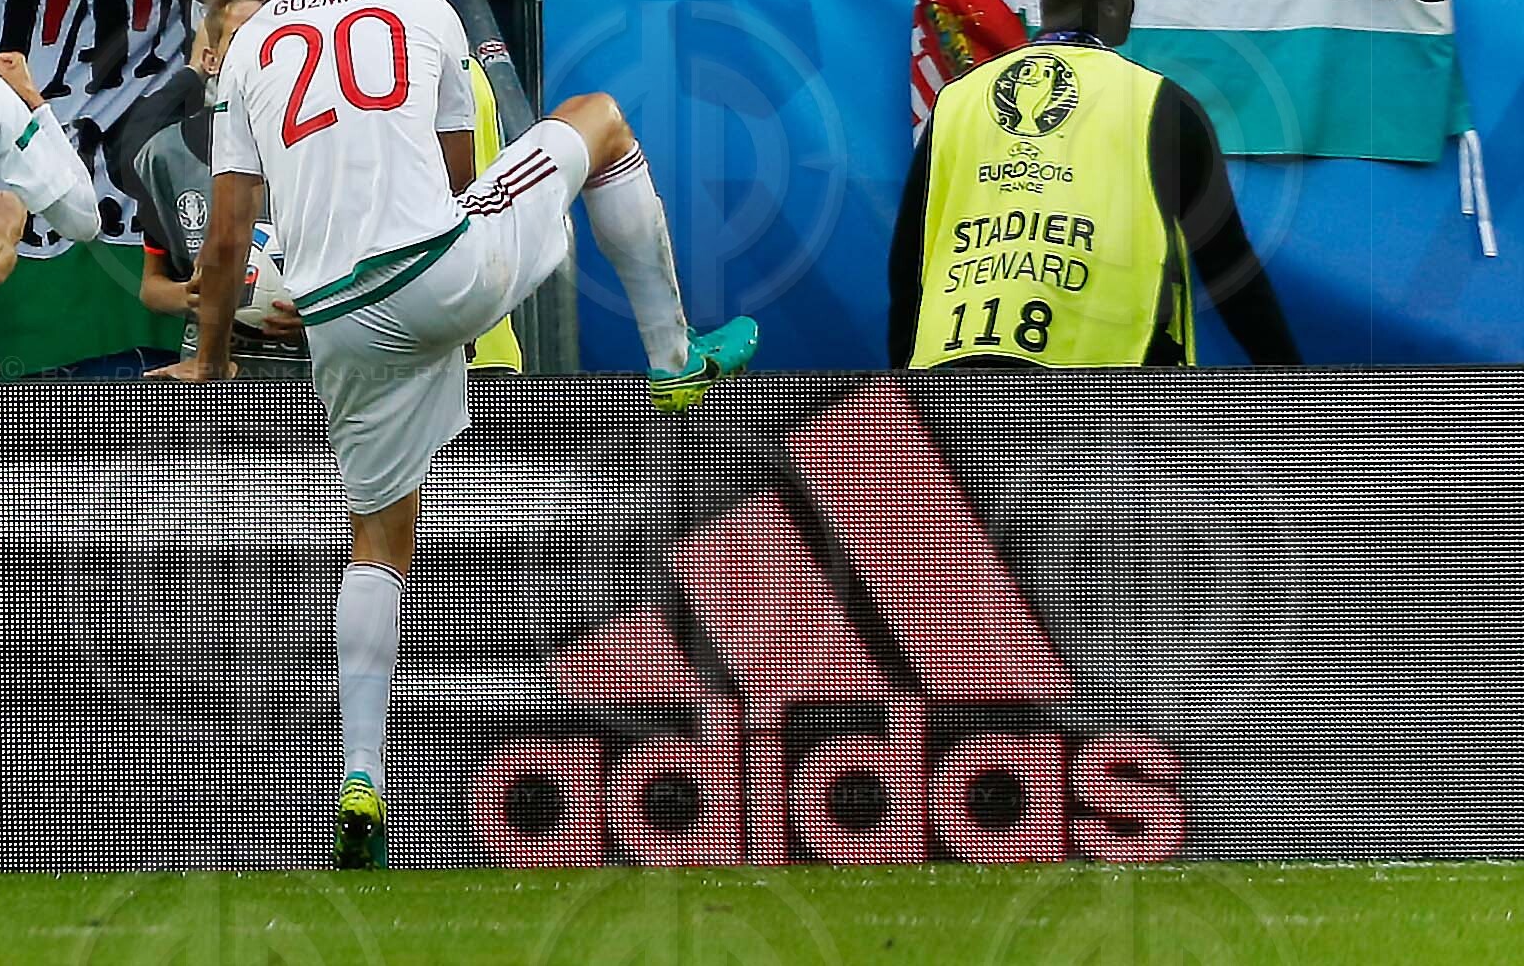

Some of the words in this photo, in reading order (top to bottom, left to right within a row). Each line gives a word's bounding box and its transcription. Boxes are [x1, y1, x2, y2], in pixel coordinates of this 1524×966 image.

[259, 6, 411, 150] 20
[978, 160, 1074, 183] EURO2016
[952, 210, 1095, 254] STADIER
[944, 250, 1089, 294] STEWARD
[943, 297, 1053, 353] 118
[468, 695, 1187, 868] adidas
